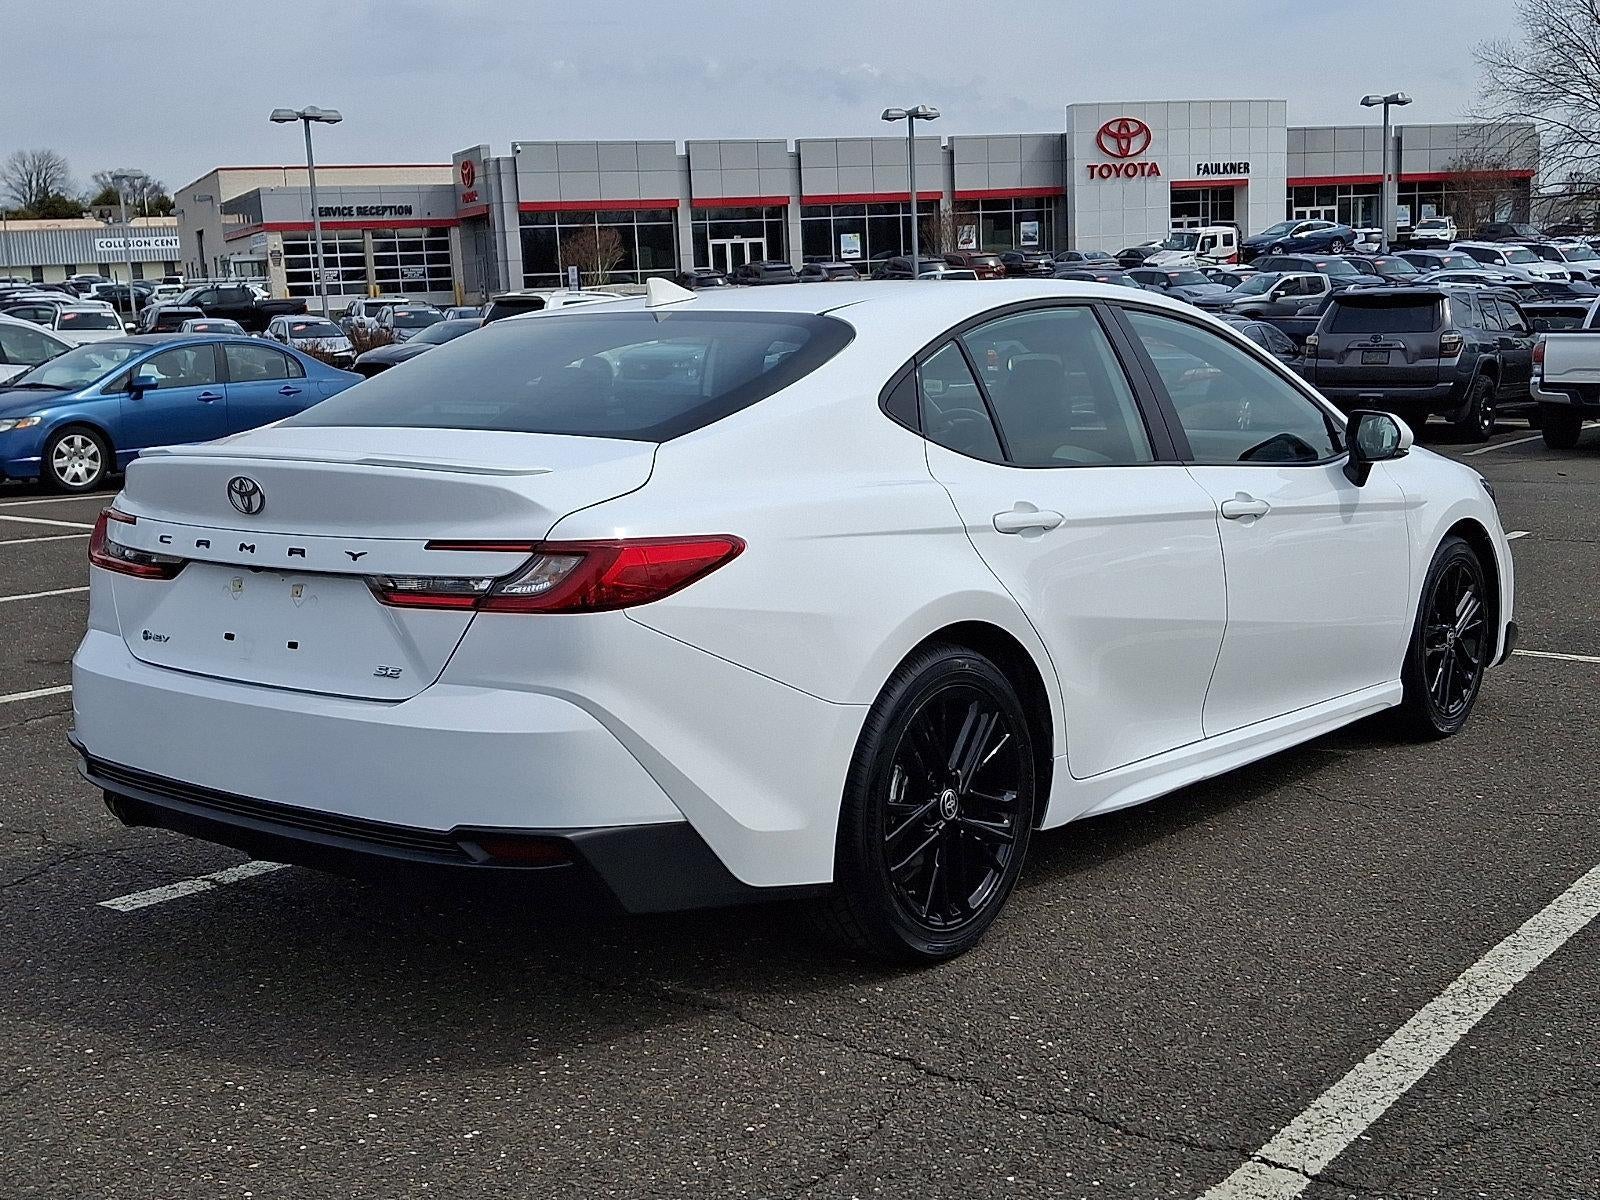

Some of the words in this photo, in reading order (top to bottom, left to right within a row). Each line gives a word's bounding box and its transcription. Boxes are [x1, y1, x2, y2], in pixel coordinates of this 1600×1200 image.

[1086, 162, 1161, 180] TOYOTA
[1196, 162, 1250, 176] FAULKNER
[311, 206, 354, 218] ERVICE
[356, 204, 413, 217] RECEPTION
[154, 238, 178, 247] CENT
[159, 534, 368, 562] CAMRY
[373, 664, 402, 679] SE
